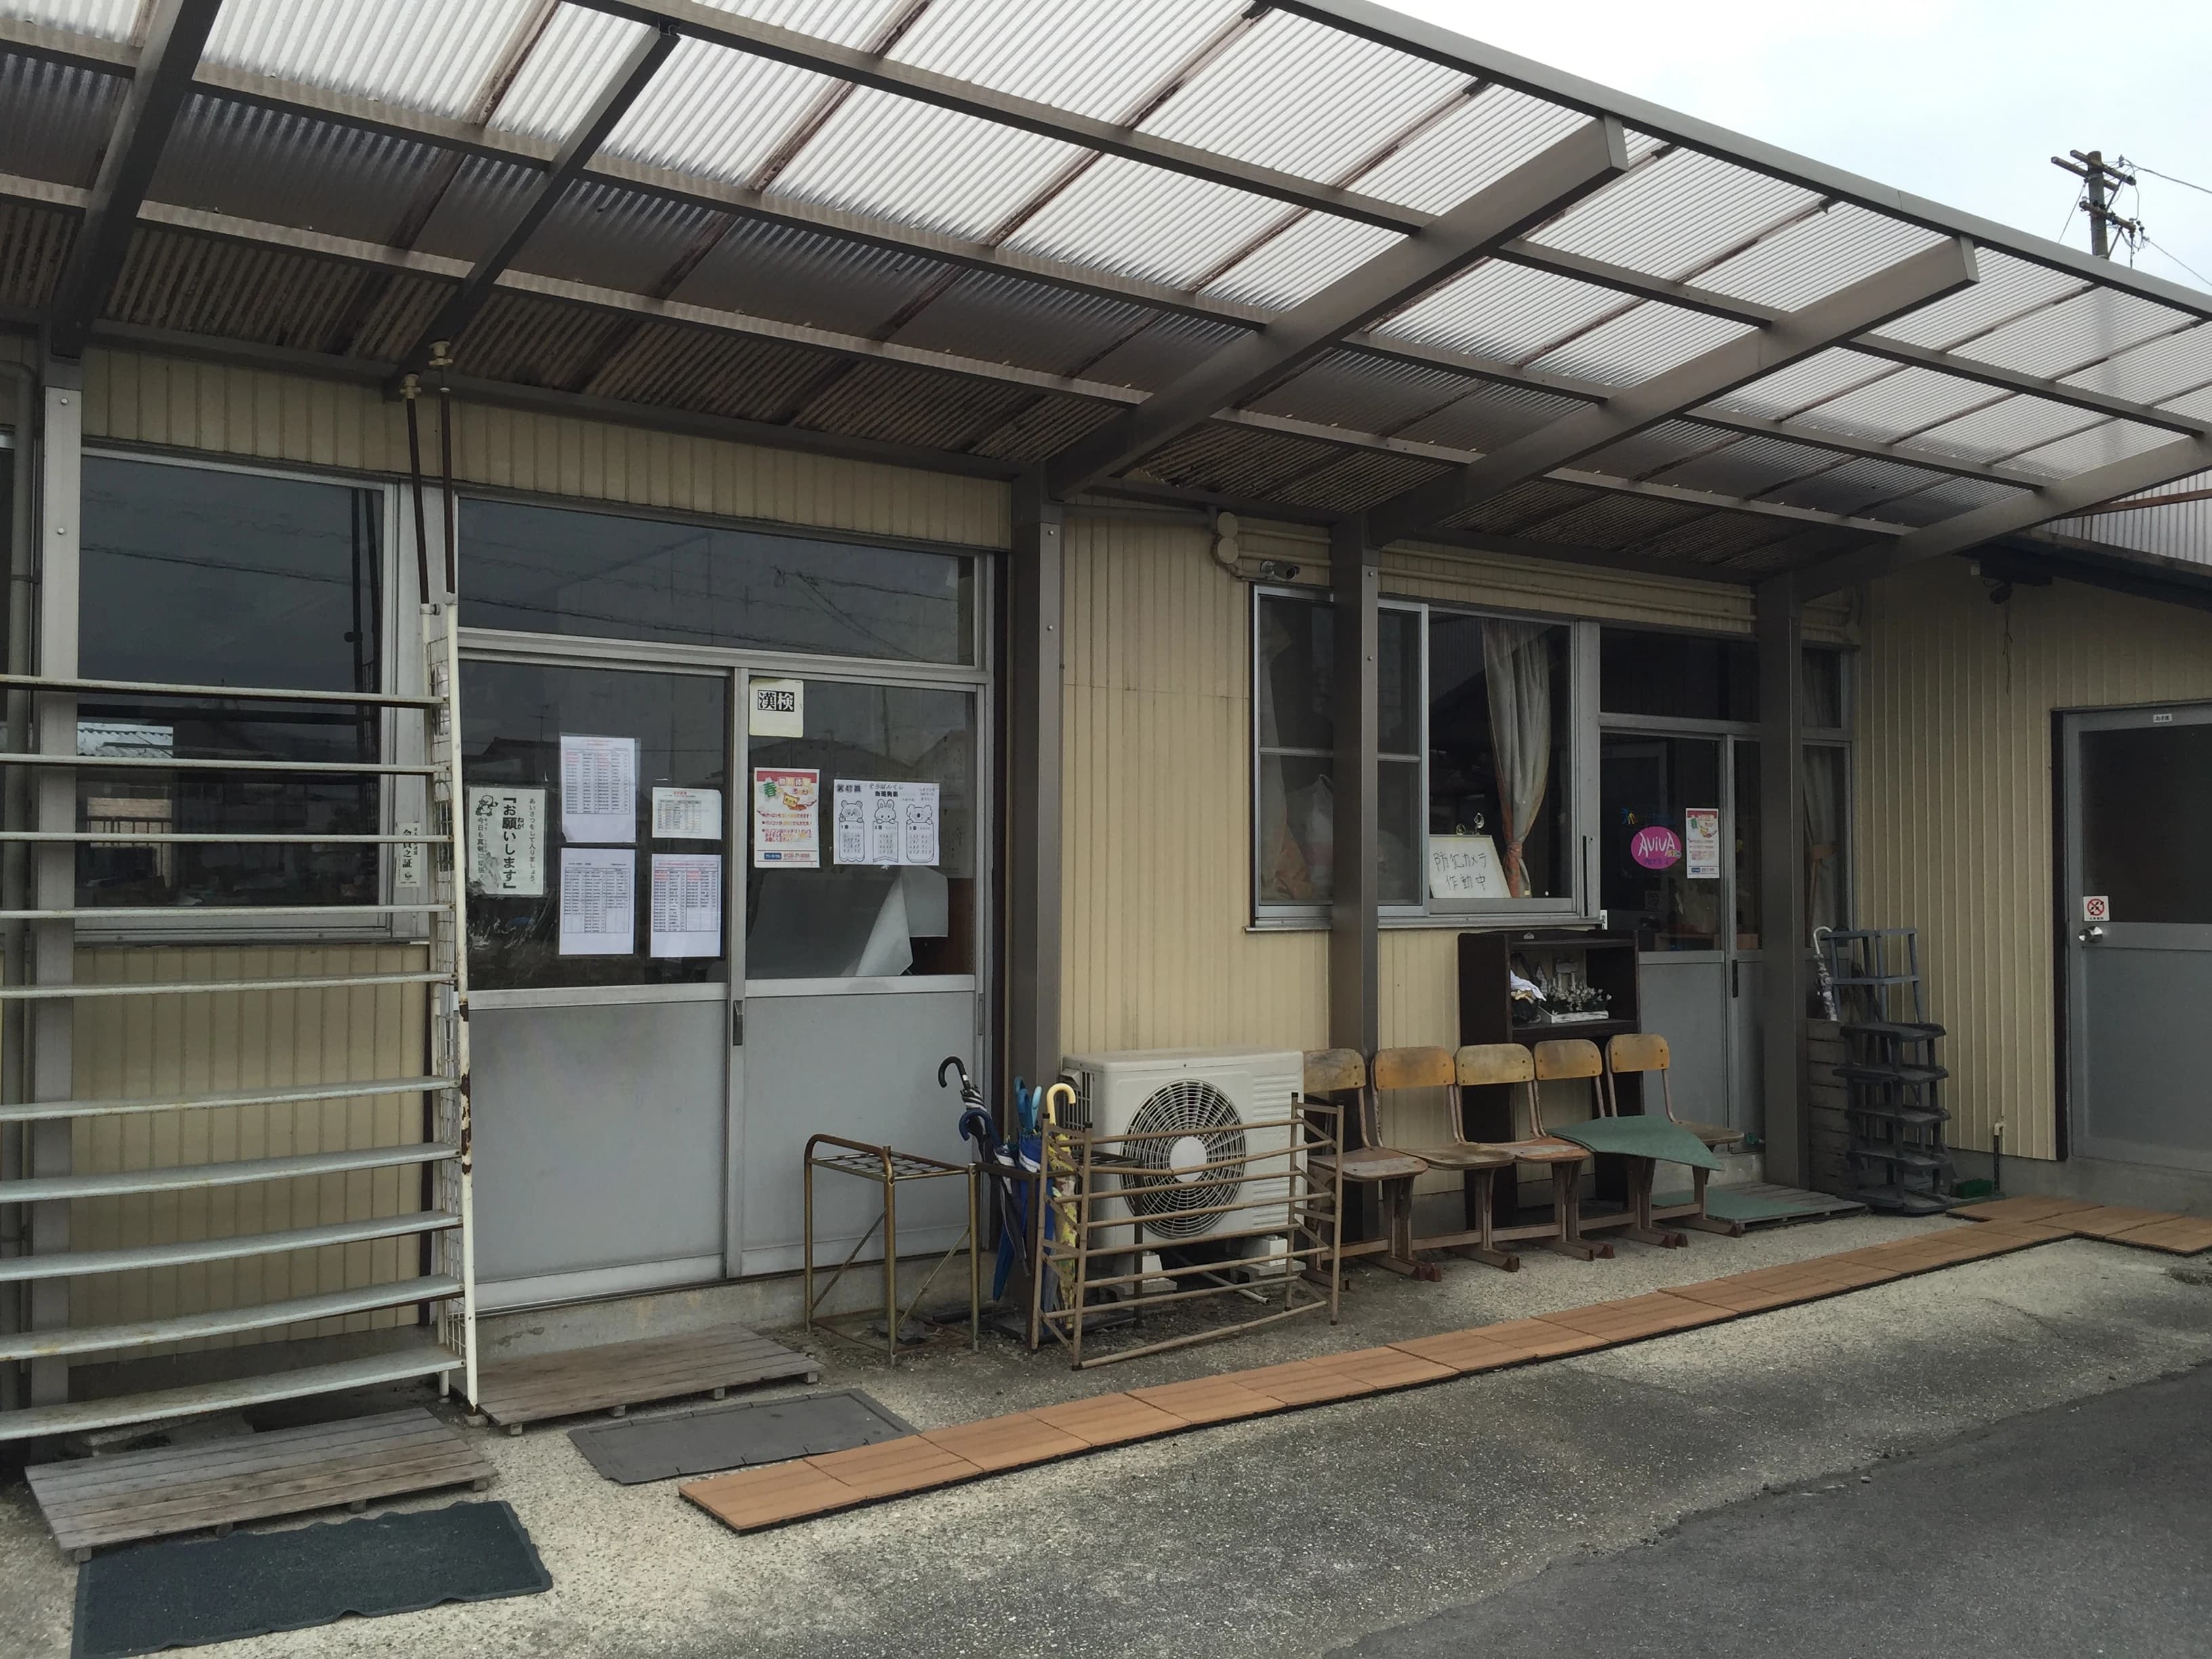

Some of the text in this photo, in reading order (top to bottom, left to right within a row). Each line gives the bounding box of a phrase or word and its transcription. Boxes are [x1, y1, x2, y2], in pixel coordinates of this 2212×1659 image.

[758, 691, 794, 711] 漢検
[1433, 852, 1486, 872] 防犯カメラ
[1446, 874, 1486, 891] 作動中
